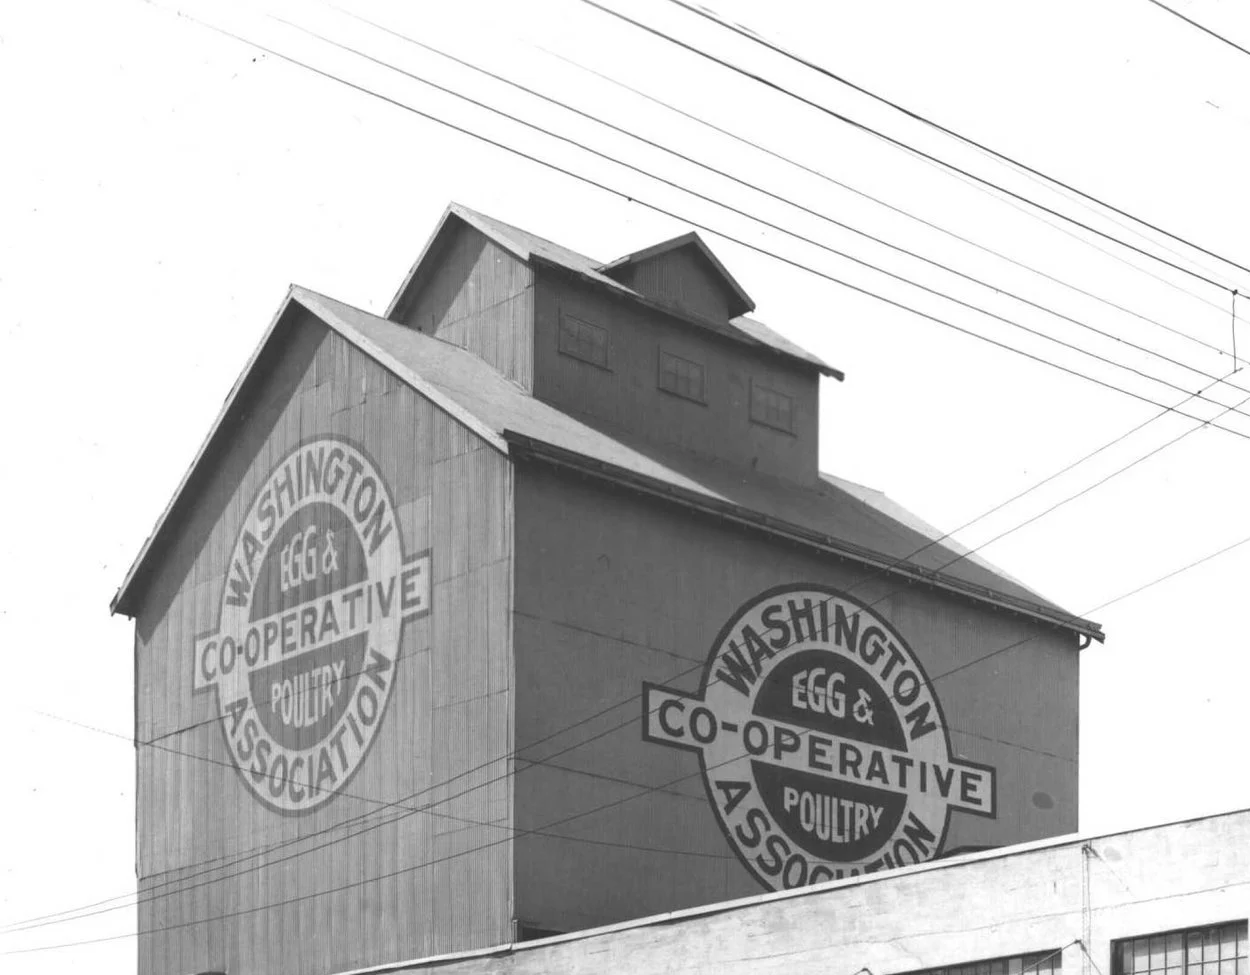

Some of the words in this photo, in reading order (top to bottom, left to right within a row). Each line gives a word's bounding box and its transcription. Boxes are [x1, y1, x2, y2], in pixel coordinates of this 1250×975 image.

[225, 445, 393, 613] WASHINGTON
[280, 525, 318, 592] EGG
[321, 529, 339, 574] &
[201, 565, 422, 682] CO-OPERATIVE
[715, 598, 937, 740] WASHINGTON
[225, 648, 393, 803] ASSOCIATION
[270, 659, 346, 729] POULTRY
[792, 667, 846, 718] EGG
[853, 688, 874, 725] &
[659, 699, 982, 806] CO-OPERATIVE
[783, 786, 884, 843] POULTRY
